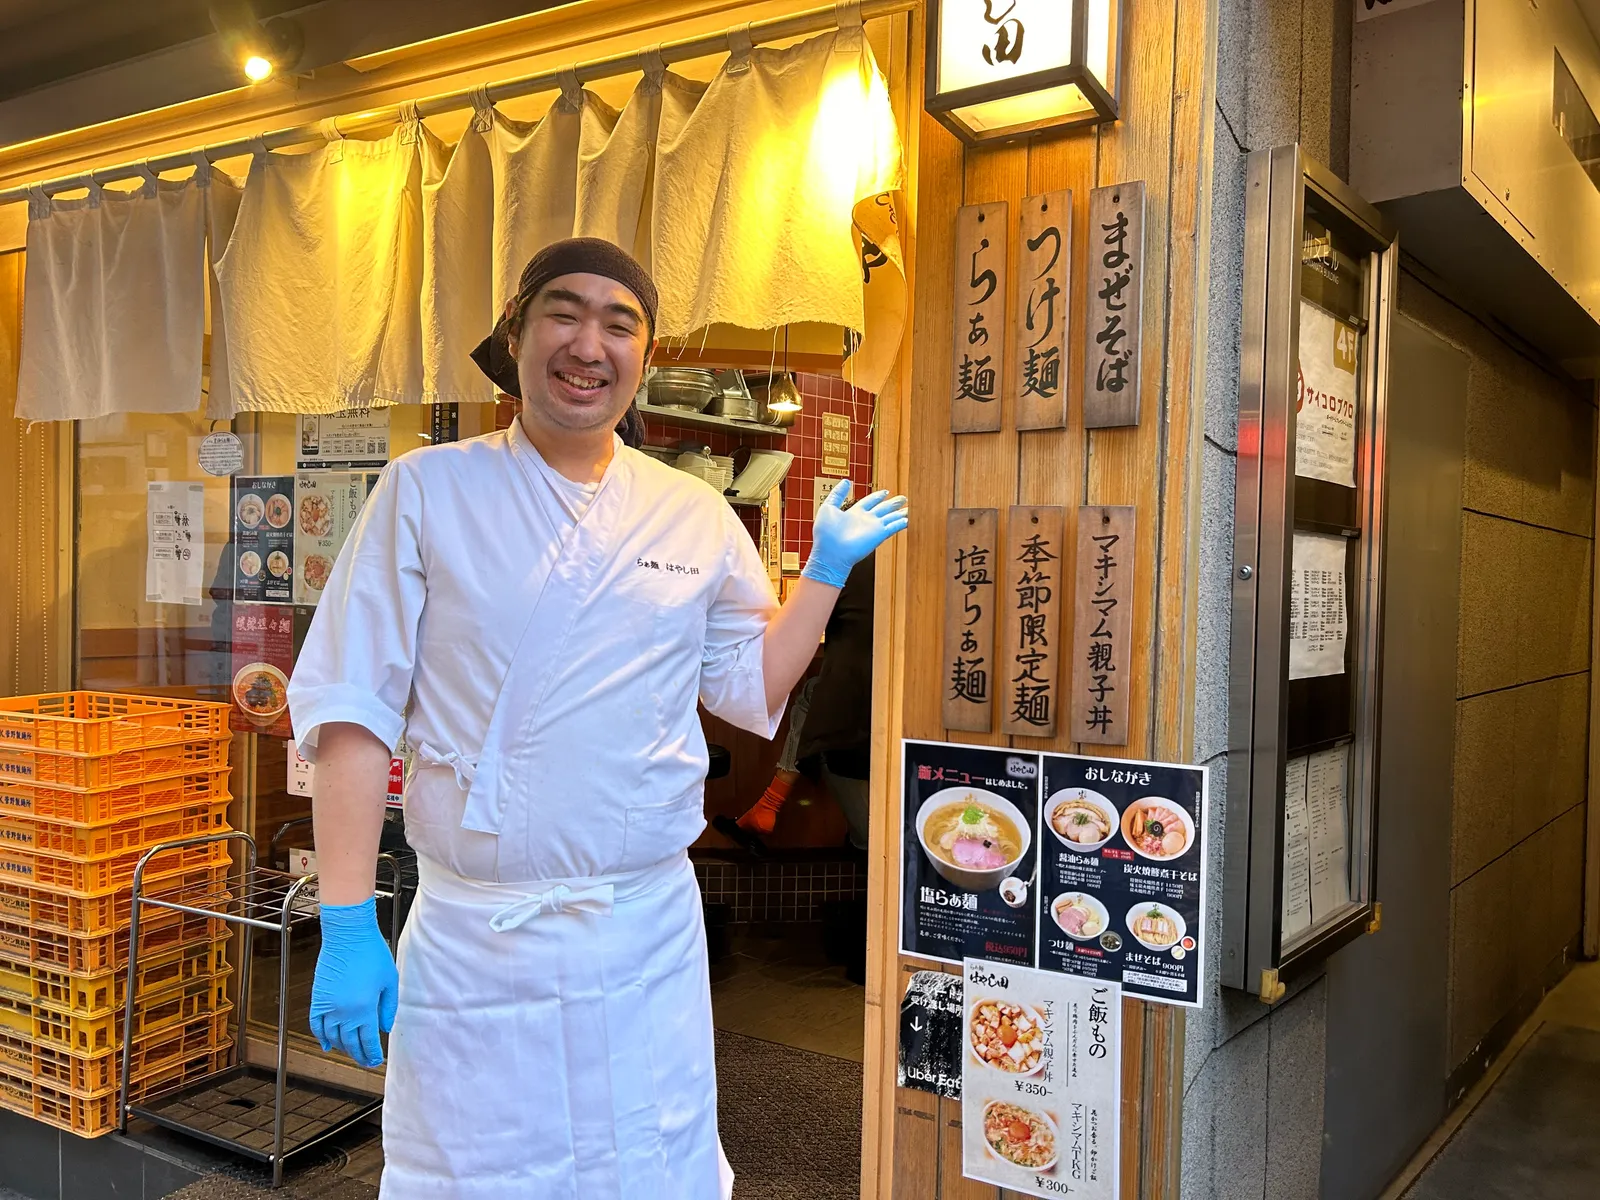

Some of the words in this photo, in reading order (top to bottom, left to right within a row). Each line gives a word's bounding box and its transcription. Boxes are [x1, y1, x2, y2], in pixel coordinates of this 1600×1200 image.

[955, 239, 997, 402] らぁ麺
[1020, 226, 1062, 399] つけ麺
[1096, 212, 1134, 393] まぜそば
[666, 562, 700, 575] はやし田
[948, 545, 993, 704] 塩らぁ麺
[1011, 534, 1057, 726] 季節限定麺
[1085, 533, 1120, 735] マキシマム親子丼
[1085, 767, 1153, 787] おしながき
[919, 886, 979, 912] 塩らぁ麺
[1048, 939, 1074, 952] つけ麺
[1125, 952, 1162, 966] まぜそば
[1043, 1000, 1054, 1083] マキシマム親子丼
[1088, 987, 1109, 1060] ご飯もの
[908, 1066, 936, 1083] Uber
[1071, 1103, 1083, 1180] マキシマムTKG
